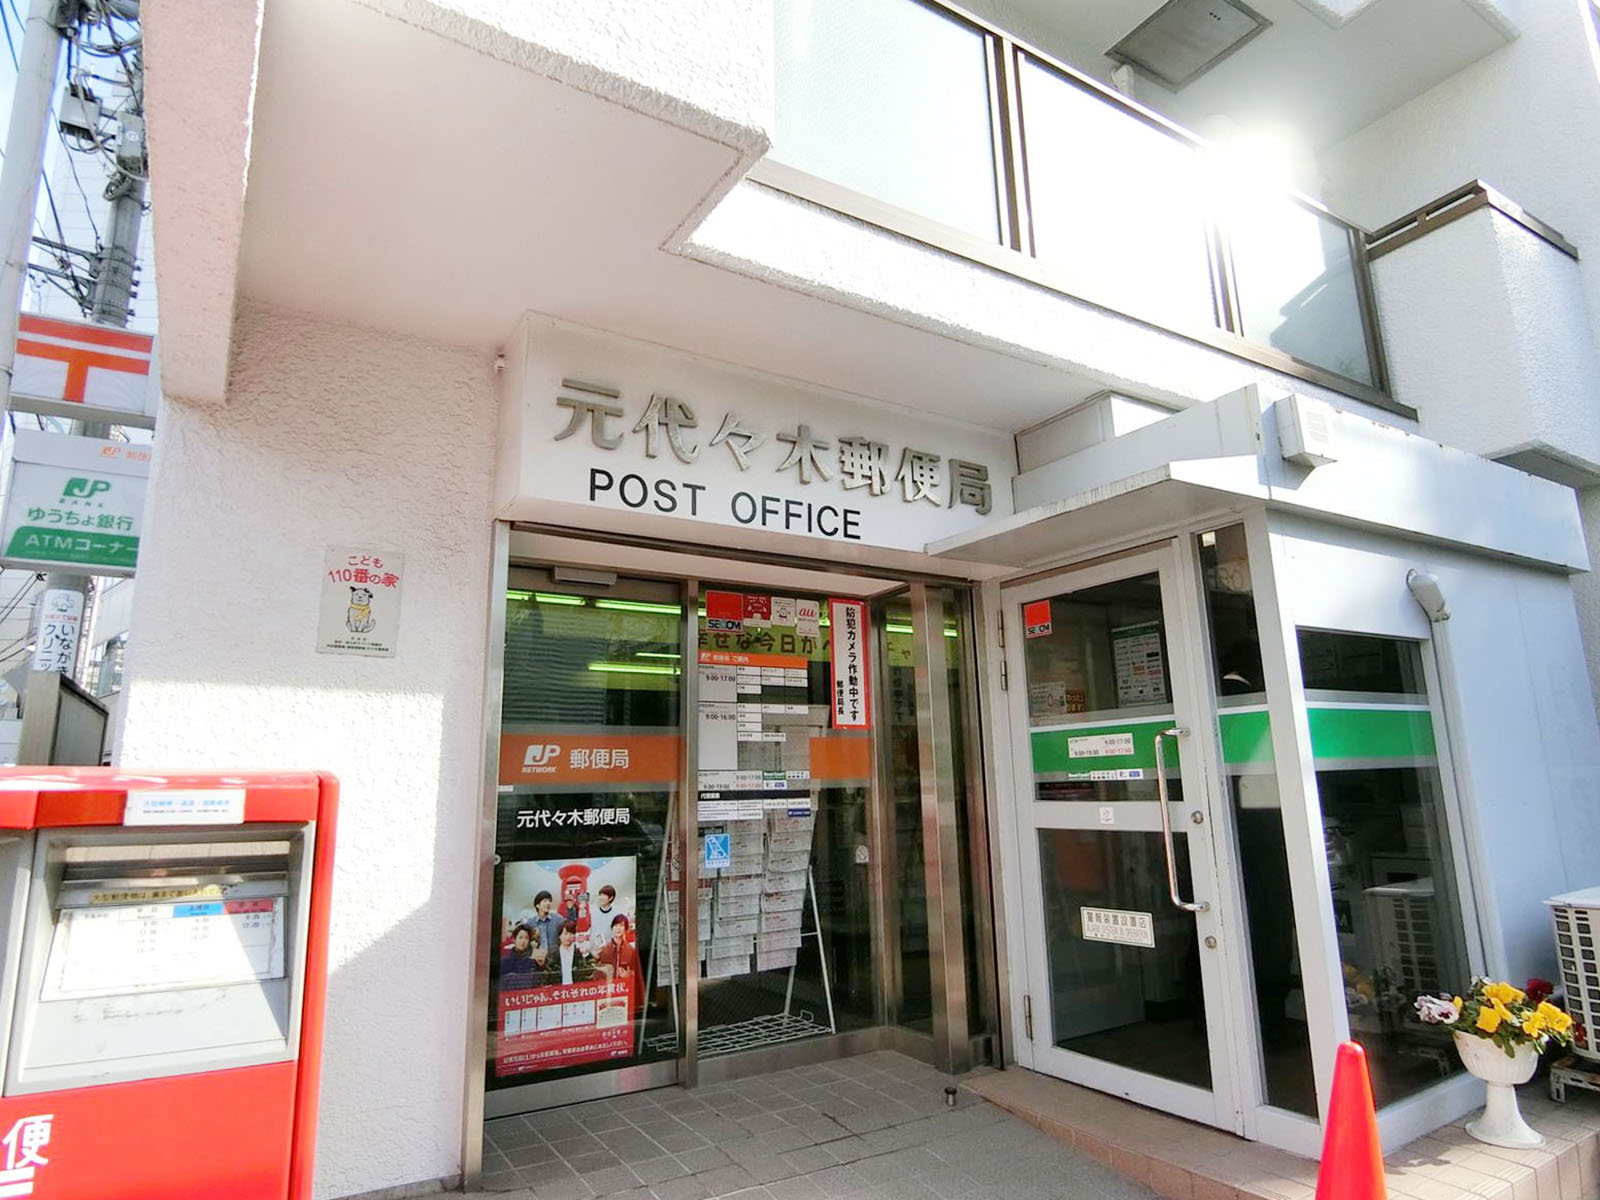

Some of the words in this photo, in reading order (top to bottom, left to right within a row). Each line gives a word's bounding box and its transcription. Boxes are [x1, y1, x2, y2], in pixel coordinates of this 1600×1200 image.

[553, 378, 993, 515] 元代々木郵便局
[63, 477, 111, 498] JP
[590, 468, 705, 516] POST
[731, 491, 861, 539] OFFICE
[27, 507, 134, 531] ゆうちょ銀行
[348, 555, 383, 568] こども
[328, 568, 400, 588] 110番の家
[800, 607, 817, 617] au
[845, 606, 860, 721] 防犯カメラ作動中です
[570, 749, 630, 769] 郵便局
[516, 808, 631, 829] 元代々木郵便局
[2, 1113, 55, 1169] 便
